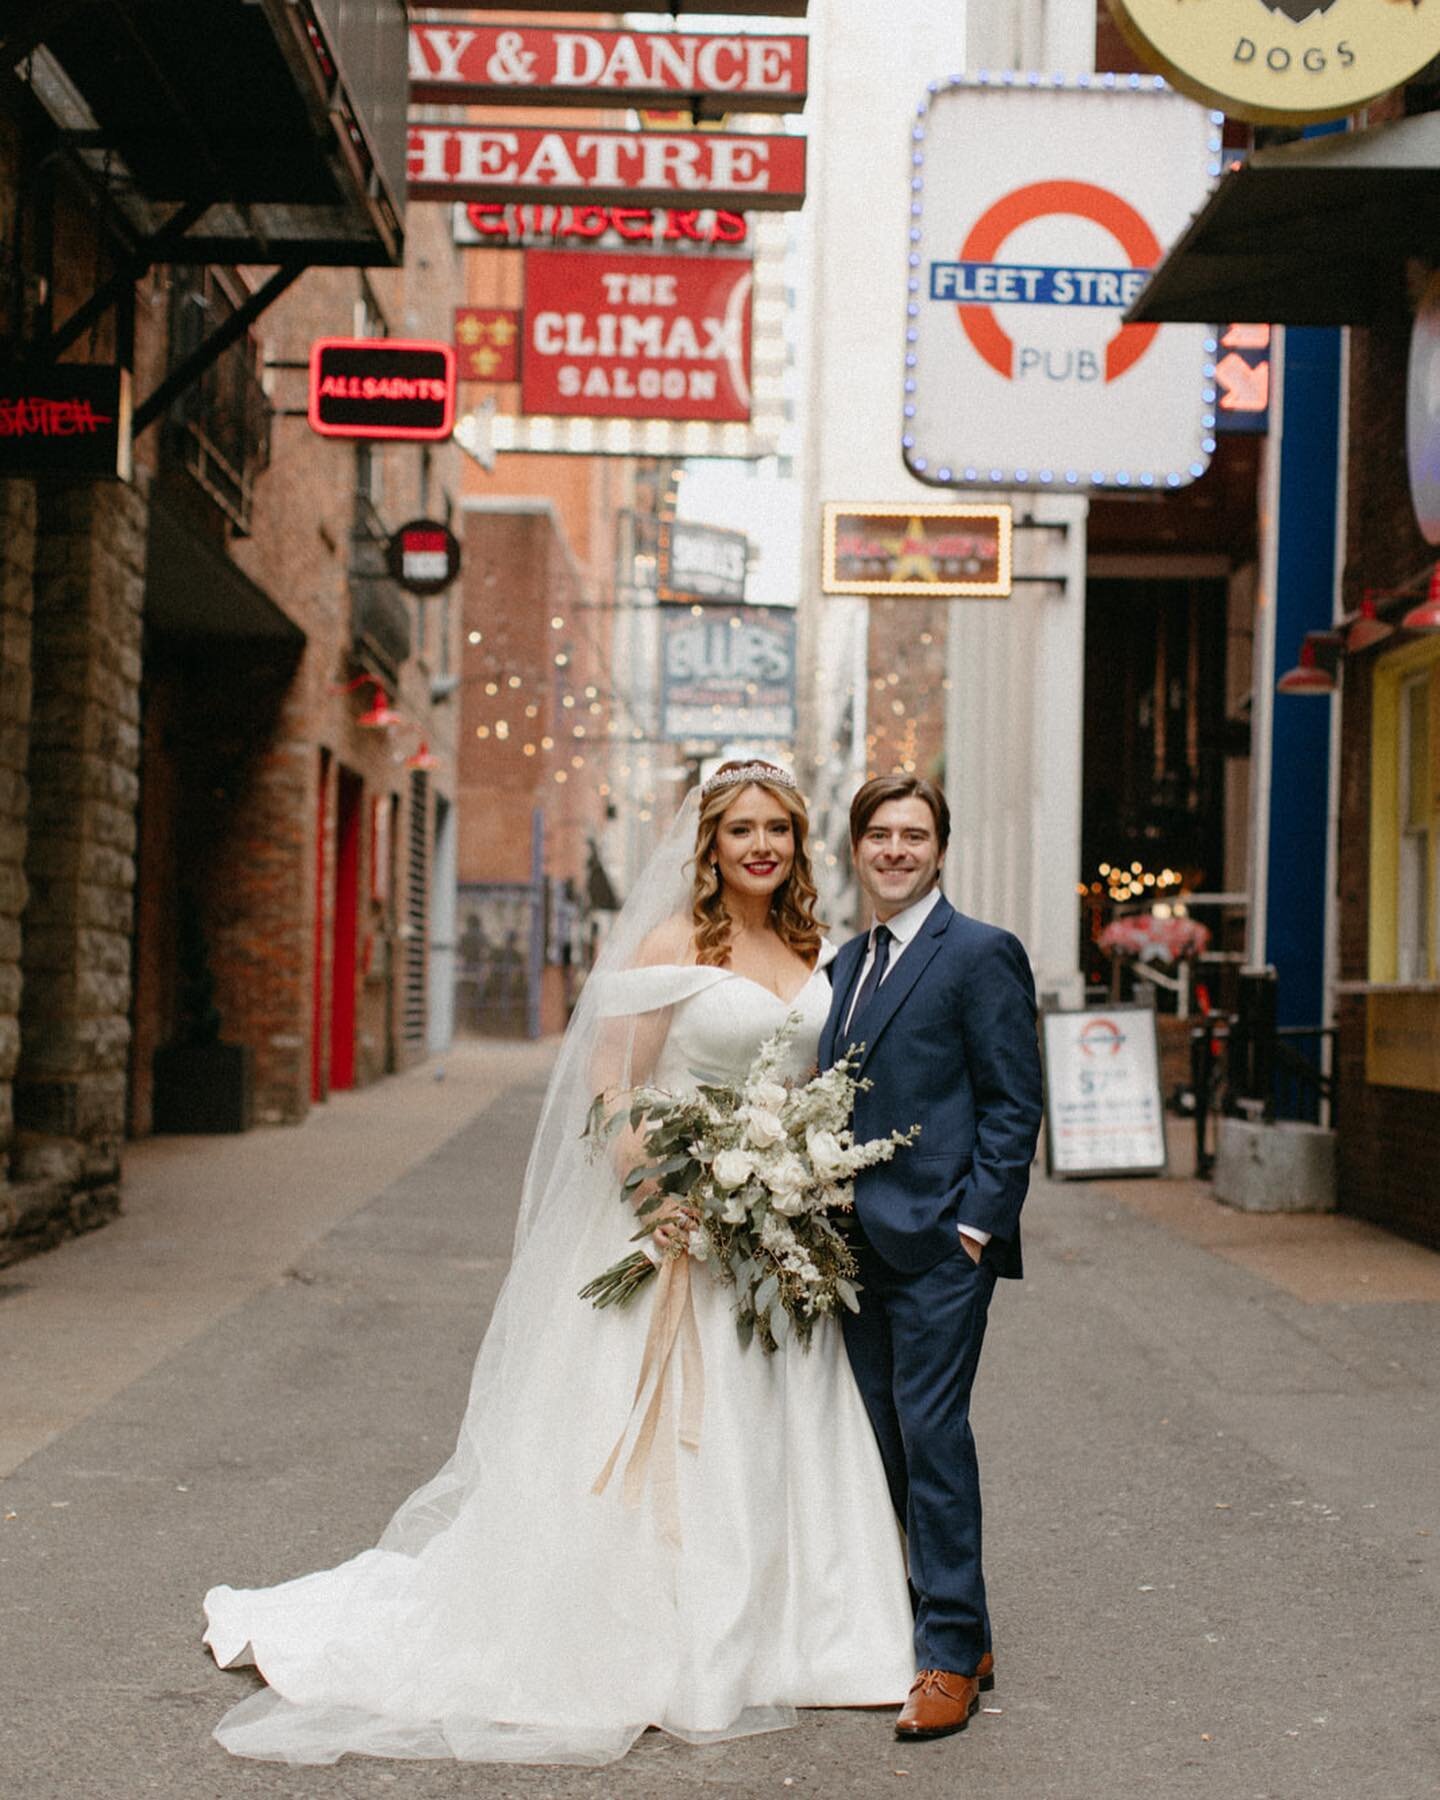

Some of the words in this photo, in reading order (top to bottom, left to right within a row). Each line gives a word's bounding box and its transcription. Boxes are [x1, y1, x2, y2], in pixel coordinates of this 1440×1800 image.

[486, 31, 538, 84] &
[552, 34, 792, 91] DANCE
[1233, 37, 1355, 72] DOGS
[602, 273, 678, 306] THE
[935, 265, 1044, 301] FLEET
[533, 311, 742, 360] CLIMAX
[557, 365, 717, 400] SALOON
[1019, 347, 1100, 383] PUB
[319, 375, 446, 404] ALLSAINTS
